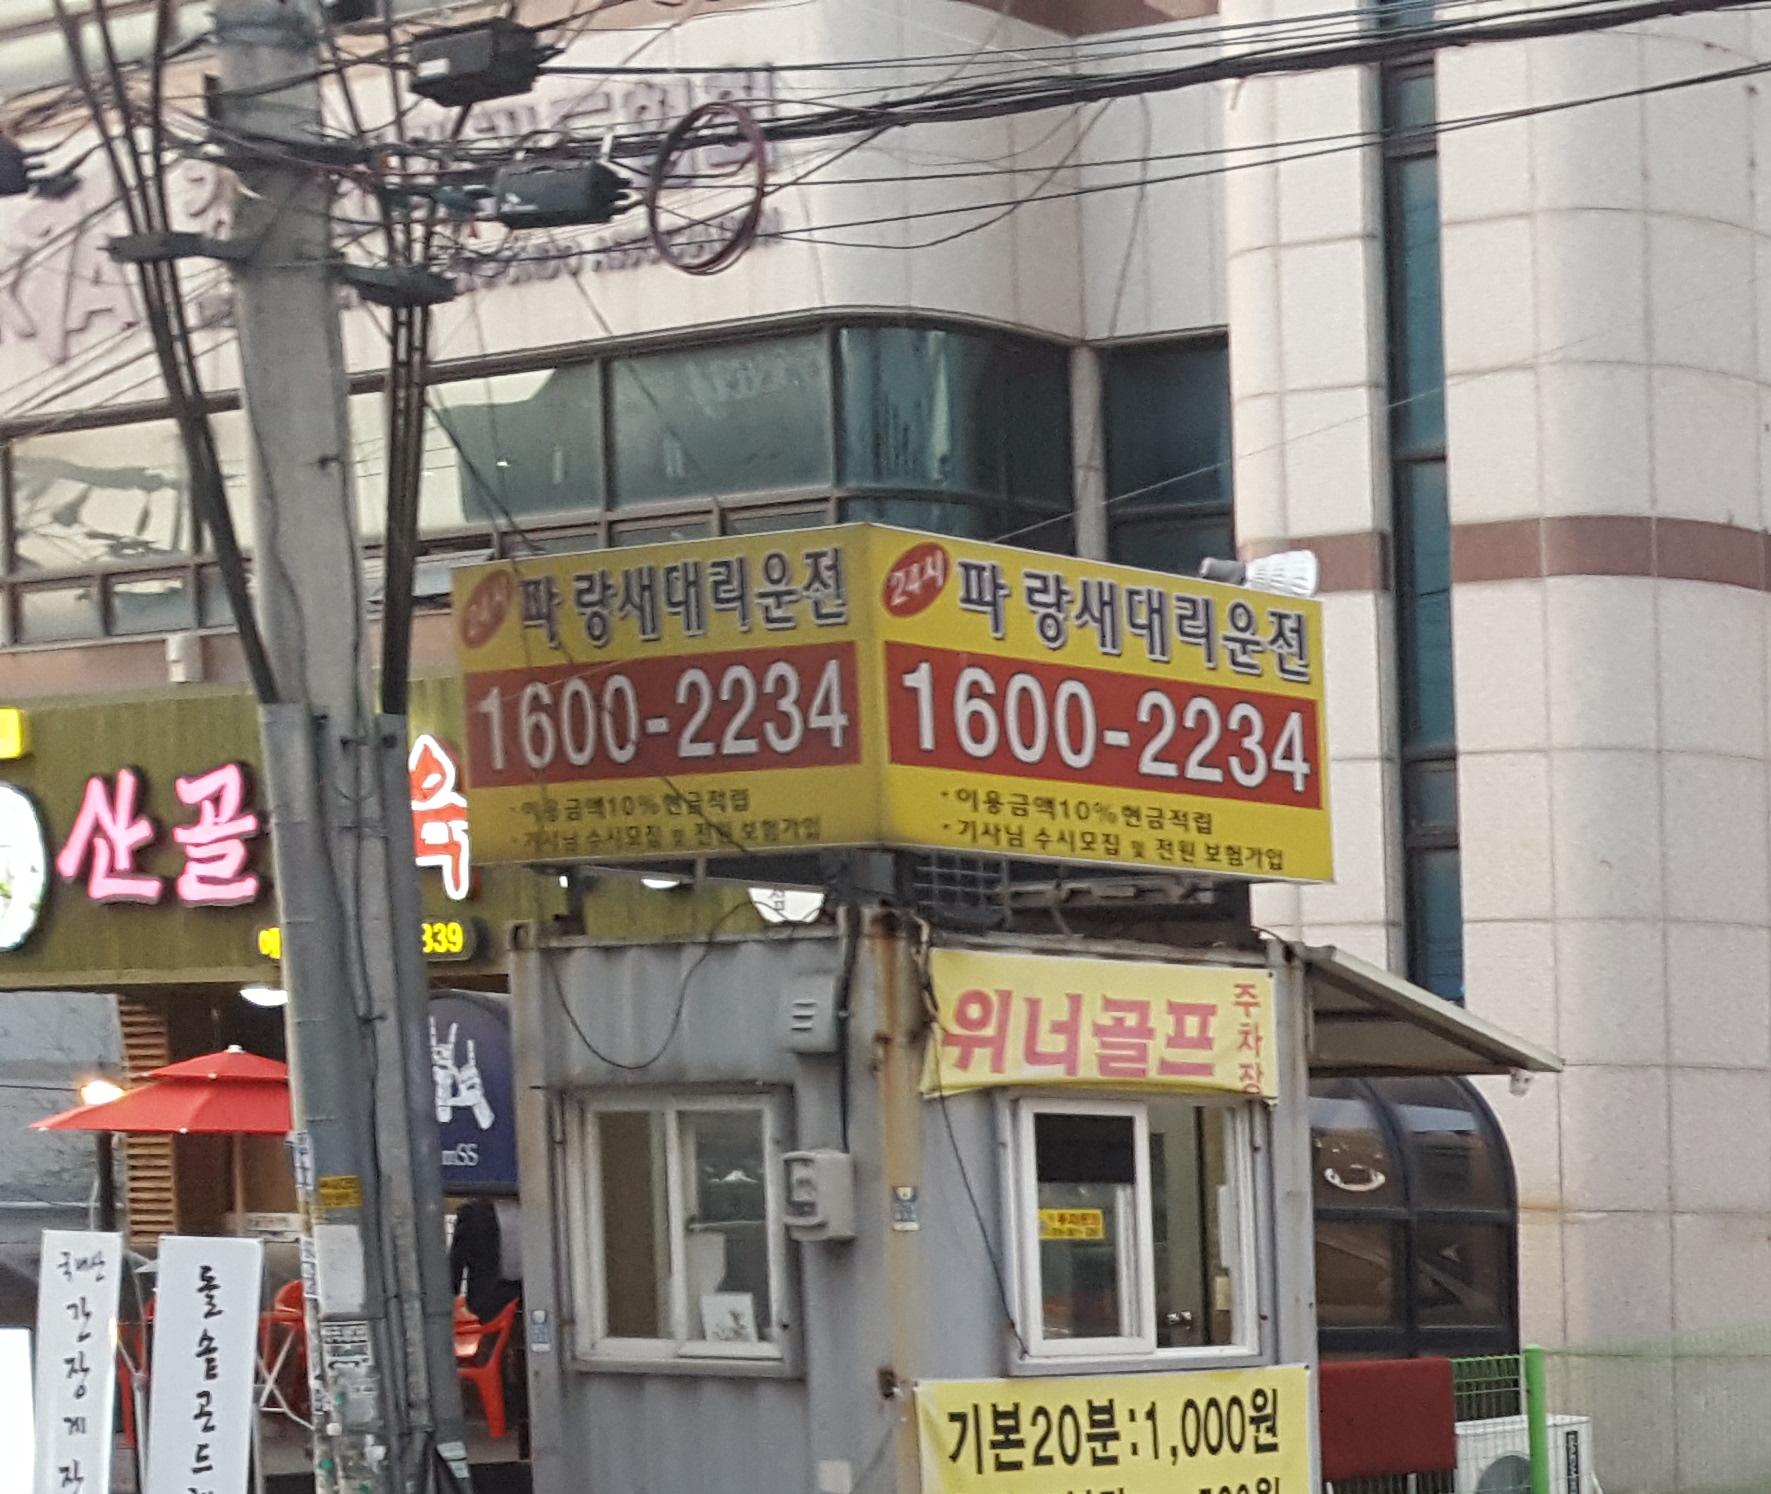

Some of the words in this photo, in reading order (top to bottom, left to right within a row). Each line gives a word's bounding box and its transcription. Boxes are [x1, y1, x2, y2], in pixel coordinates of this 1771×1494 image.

[478, 658, 848, 771] 1600-2234
[902, 660, 1312, 793] 1600-2234
[958, 819, 1025, 849] 기사님
[1033, 825, 1121, 857] 수시모집
[1155, 837, 1197, 863] 전원
[1204, 842, 1285, 872] 보험가입
[942, 987, 1217, 1079] 위너골프
